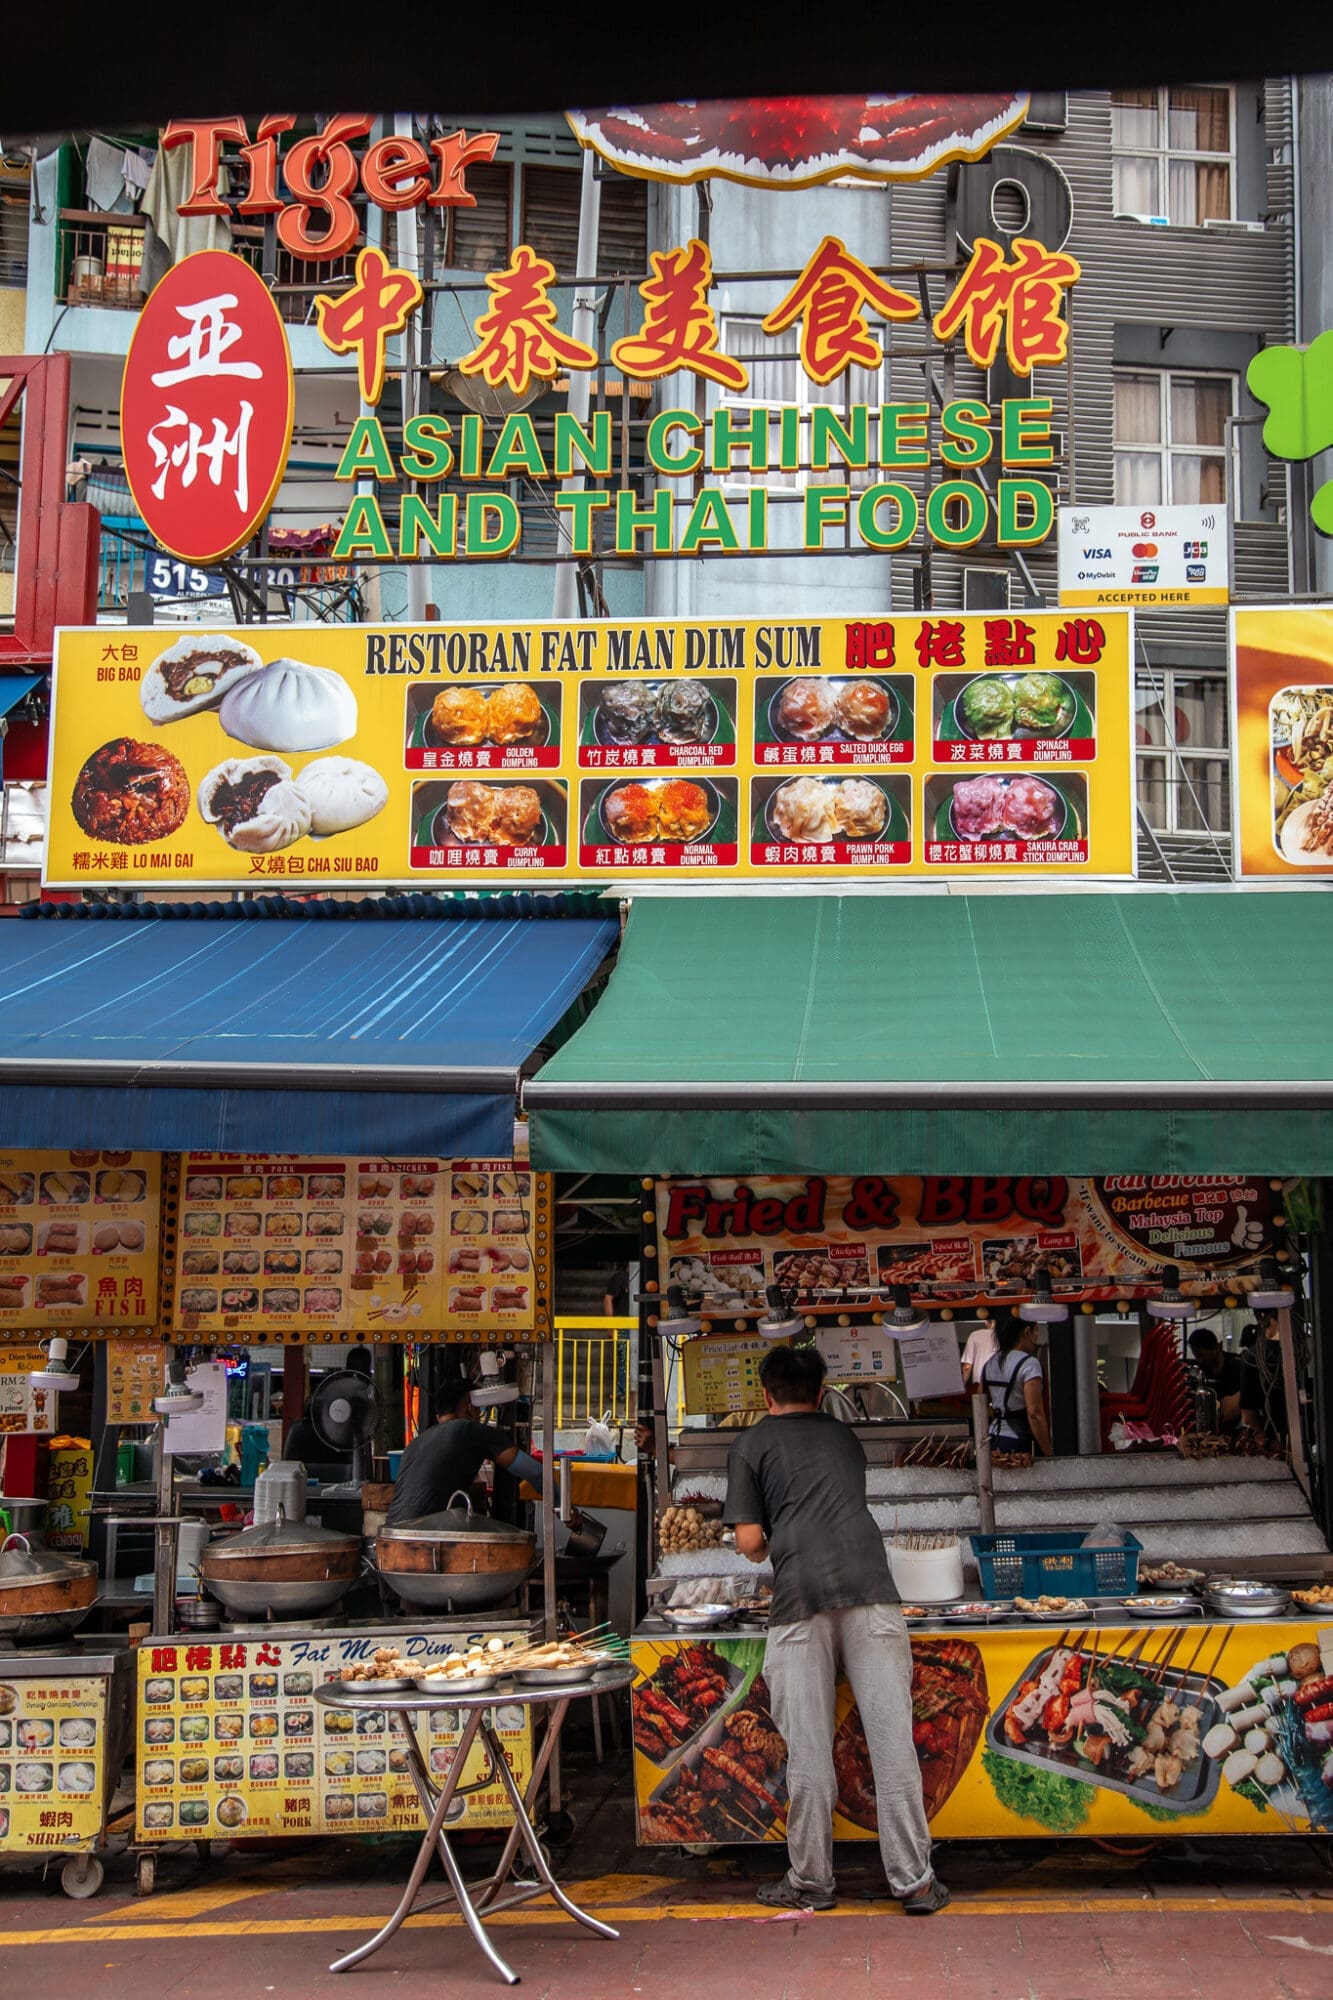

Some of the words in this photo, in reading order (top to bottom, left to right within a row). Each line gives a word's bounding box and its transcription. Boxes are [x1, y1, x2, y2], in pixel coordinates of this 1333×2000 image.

[162, 113, 500, 261] Tiger
[315, 234, 1081, 405] 中泰美食馆
[147, 293, 263, 513] 亚洲
[336, 410, 612, 483] ASIAN
[646, 398, 1056, 476] CHINESE
[332, 492, 522, 560] AND
[554, 486, 768, 556] THAI
[804, 478, 1057, 551] FOOD
[1082, 548, 1112, 559] VISA
[152, 558, 209, 592] 515
[1097, 593, 1157, 602] ACCEPTED
[1161, 592, 1190, 601] HERE
[844, 618, 1106, 669] 肥佬點心
[102, 644, 138, 662] 大包
[365, 631, 532, 675] RESTORAN
[540, 629, 597, 672] FAT
[606, 628, 676, 672] MAN
[684, 627, 746, 670] DIM
[755, 626, 822, 669] SUM
[97, 667, 117, 681] BIG
[118, 666, 141, 681] BAO
[840, 744, 866, 754] SALTED
[868, 743, 888, 753] DUCK
[889, 743, 904, 753] EGG
[1036, 740, 1069, 751] SPINACH
[506, 748, 534, 758] GOLDEN
[669, 747, 707, 757] CHARCOAL
[709, 746, 723, 756] RED
[1033, 750, 1072, 761] DUMPLING
[502, 757, 538, 768] DUMPLING
[677, 756, 715, 766] DUMPLING
[853, 753, 891, 764] DUMPLING
[684, 845, 714, 855] NORMAL
[846, 844, 873, 855] PRAWN
[873, 844, 895, 854] PORK
[1026, 841, 1060, 852] SAKURA
[1060, 841, 1079, 851] CRAB
[514, 848, 538, 858] CURRY
[1022, 851, 1045, 862] STICK
[1046, 850, 1085, 862] DUMPLING
[133, 854, 148, 868] LO
[150, 853, 172, 868] MAI
[174, 853, 194, 868] GAI
[248, 855, 304, 874] 叉燒包
[307, 857, 331, 873] CHA
[333, 857, 353, 872] SIU
[355, 856, 378, 872] BAO
[507, 857, 545, 867] DUMPLING
[680, 854, 718, 865] DUMPLING
[851, 854, 889, 864] DUMPLING
[493, 1163, 513, 1171] FISH
[1111, 1190, 1191, 1213] Barbecue
[663, 1177, 827, 1240] Fried
[842, 1175, 900, 1230] &
[916, 1175, 1069, 1229] BBQ
[1086, 1203, 1107, 1231] want
[1104, 1231, 1115, 1243] to
[1129, 1212, 1192, 1230] Malaysia
[1194, 1206, 1224, 1224] Top
[1148, 1227, 1215, 1245] Delicious
[831, 1247, 857, 1257] Chicken
[934, 1242, 953, 1251] Squid
[1173, 1241, 1231, 1258] Famous
[98, 1276, 144, 1297] 魚肉
[95, 1299, 146, 1317] FISH
[703, 1344, 723, 1353] Price
[724, 1343, 738, 1352] List
[9, 1353, 25, 1361] Dim
[26, 1352, 45, 1360] Sum
[1, 1376, 17, 1385] RM
[20, 1376, 26, 1385] 2
[290, 1642, 330, 1666] Fat
[406, 1636, 454, 1657] Dim
[40, 1811, 72, 1827] 蝦肉
[282, 1816, 312, 1828] PORK
[392, 1814, 419, 1825] FISH
